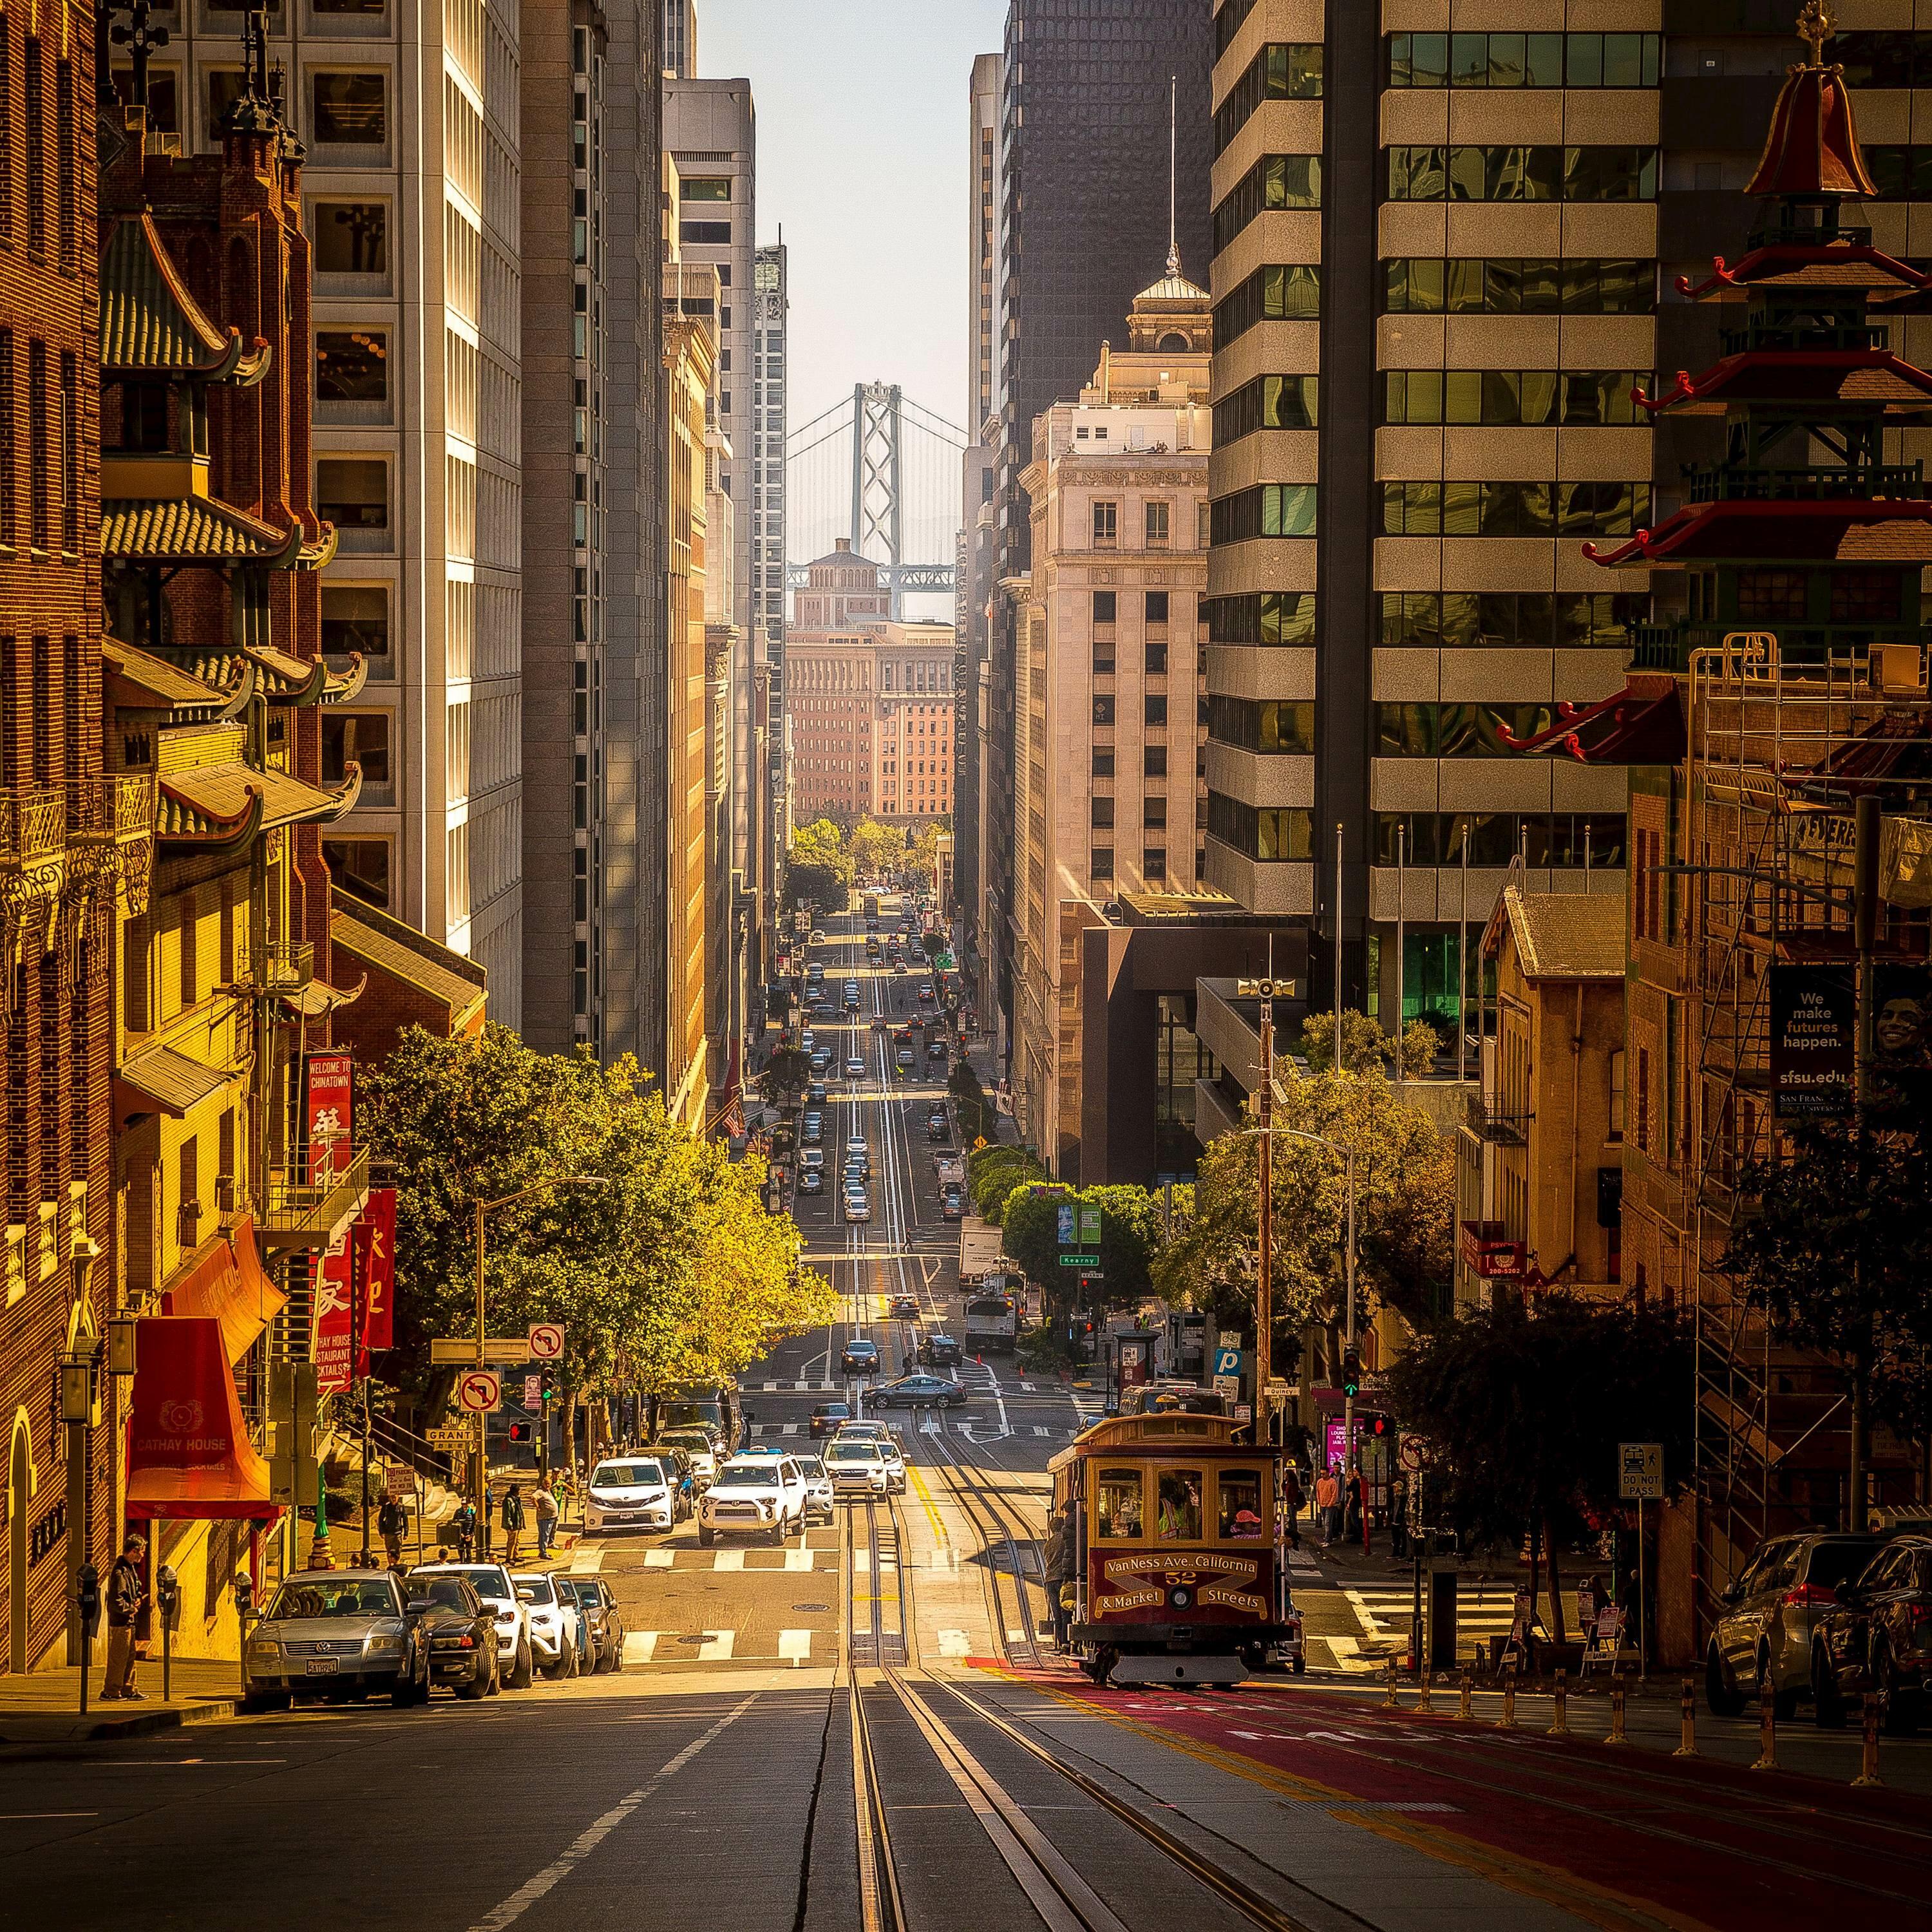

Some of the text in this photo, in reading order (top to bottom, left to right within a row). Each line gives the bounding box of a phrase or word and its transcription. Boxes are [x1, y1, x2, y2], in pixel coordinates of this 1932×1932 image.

[1800, 992, 1824, 1005] We
[1793, 1006, 1832, 1019] make
[1786, 1021, 1838, 1033] futures
[1783, 1035, 1842, 1050] happen.
[310, 1061, 351, 1074] WELCOME TO
[311, 1075, 348, 1088] CHINATOWN
[1779, 1070, 1845, 1084] sfsu.edu
[317, 1334, 352, 1348] THAY HOUSE
[317, 1349, 351, 1363] STAURANT
[317, 1364, 343, 1378] CKTAILS
[430, 1431, 471, 1439] GRANT
[137, 1439, 226, 1452] CATHAY HOUSE
[1623, 1475, 1660, 1484] DO NOT
[1629, 1486, 1654, 1495] PASS
[1108, 1560, 1129, 1573] Van
[1131, 1557, 1160, 1569] Ness
[1195, 1556, 1255, 1573] California
[1165, 1571, 1197, 1585] 52
[1103, 1591, 1159, 1608] & Market
[1208, 1589, 1258, 1607] Streets
